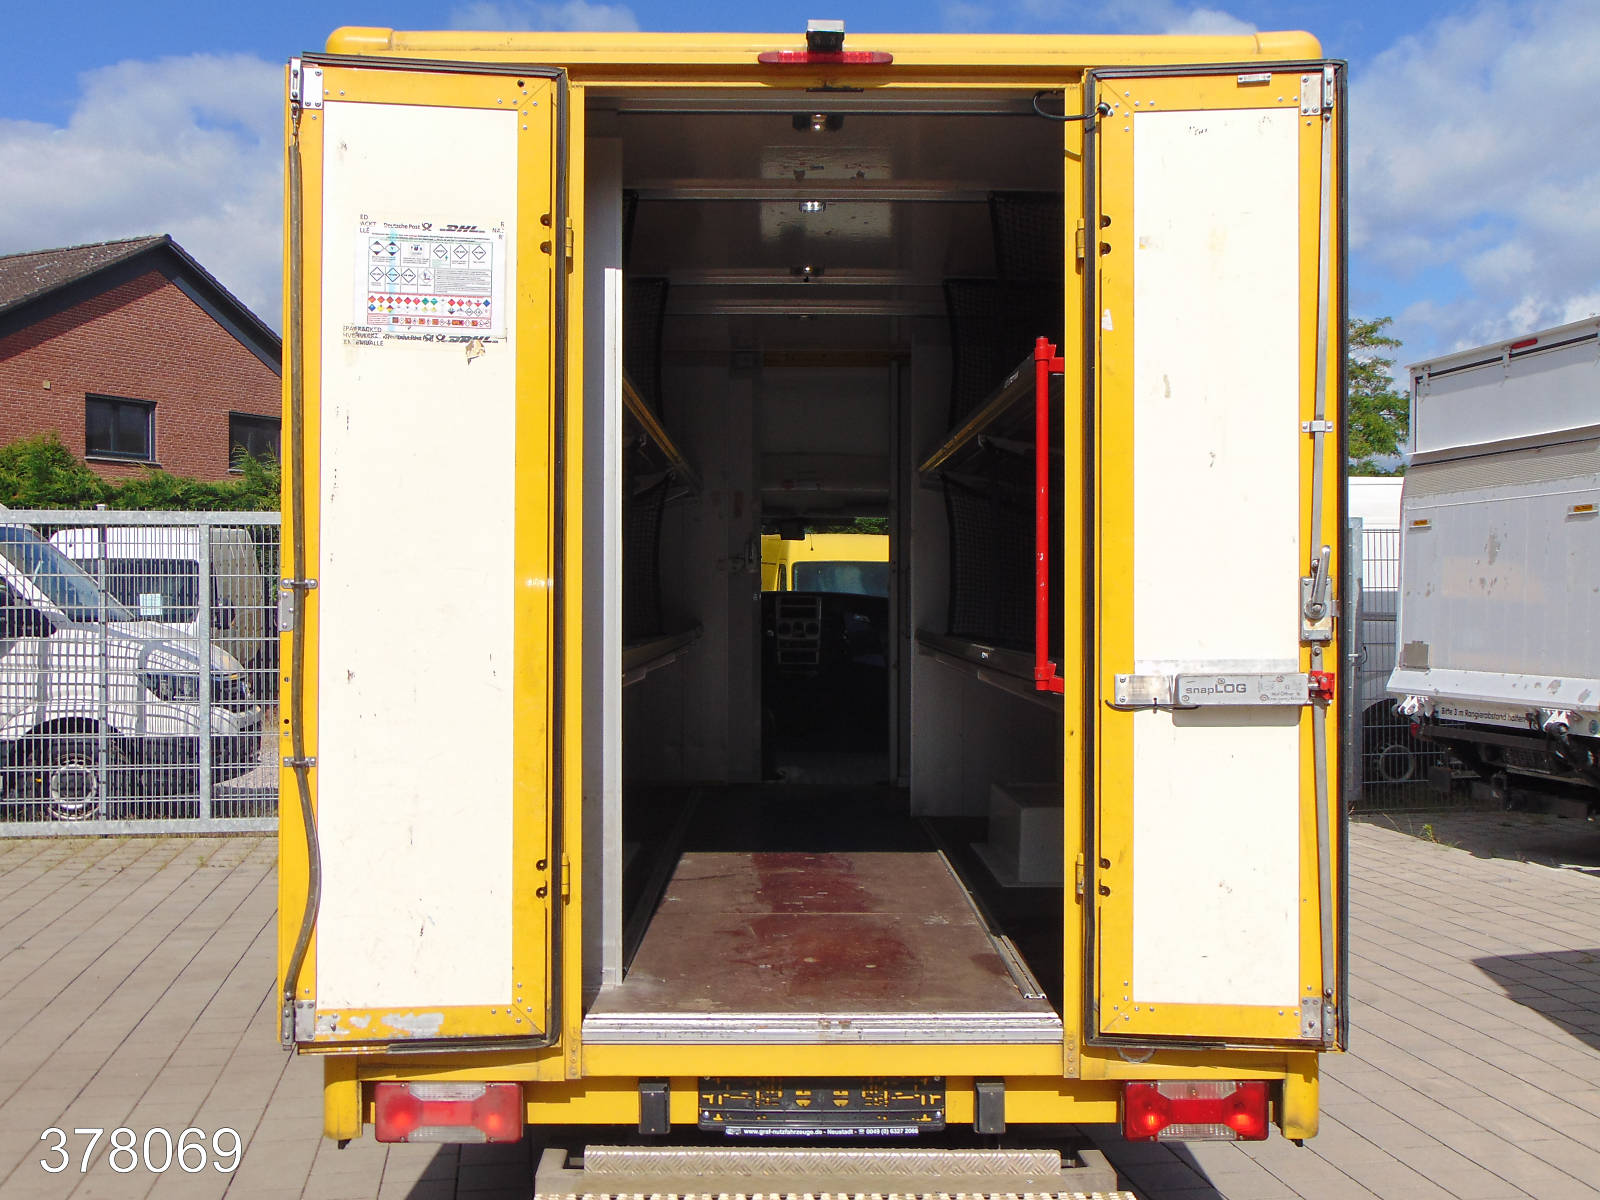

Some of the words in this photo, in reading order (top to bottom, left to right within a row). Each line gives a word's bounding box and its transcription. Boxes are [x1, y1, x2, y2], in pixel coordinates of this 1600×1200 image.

[440, 224, 485, 233] DHL
[1185, 683, 1247, 695] snapLOG
[1441, 707, 1453, 716] Bitte
[1464, 709, 1506, 721] Rangierabstand
[743, 1128, 823, 1136] www.graf-nutzfahrzeuge.de
